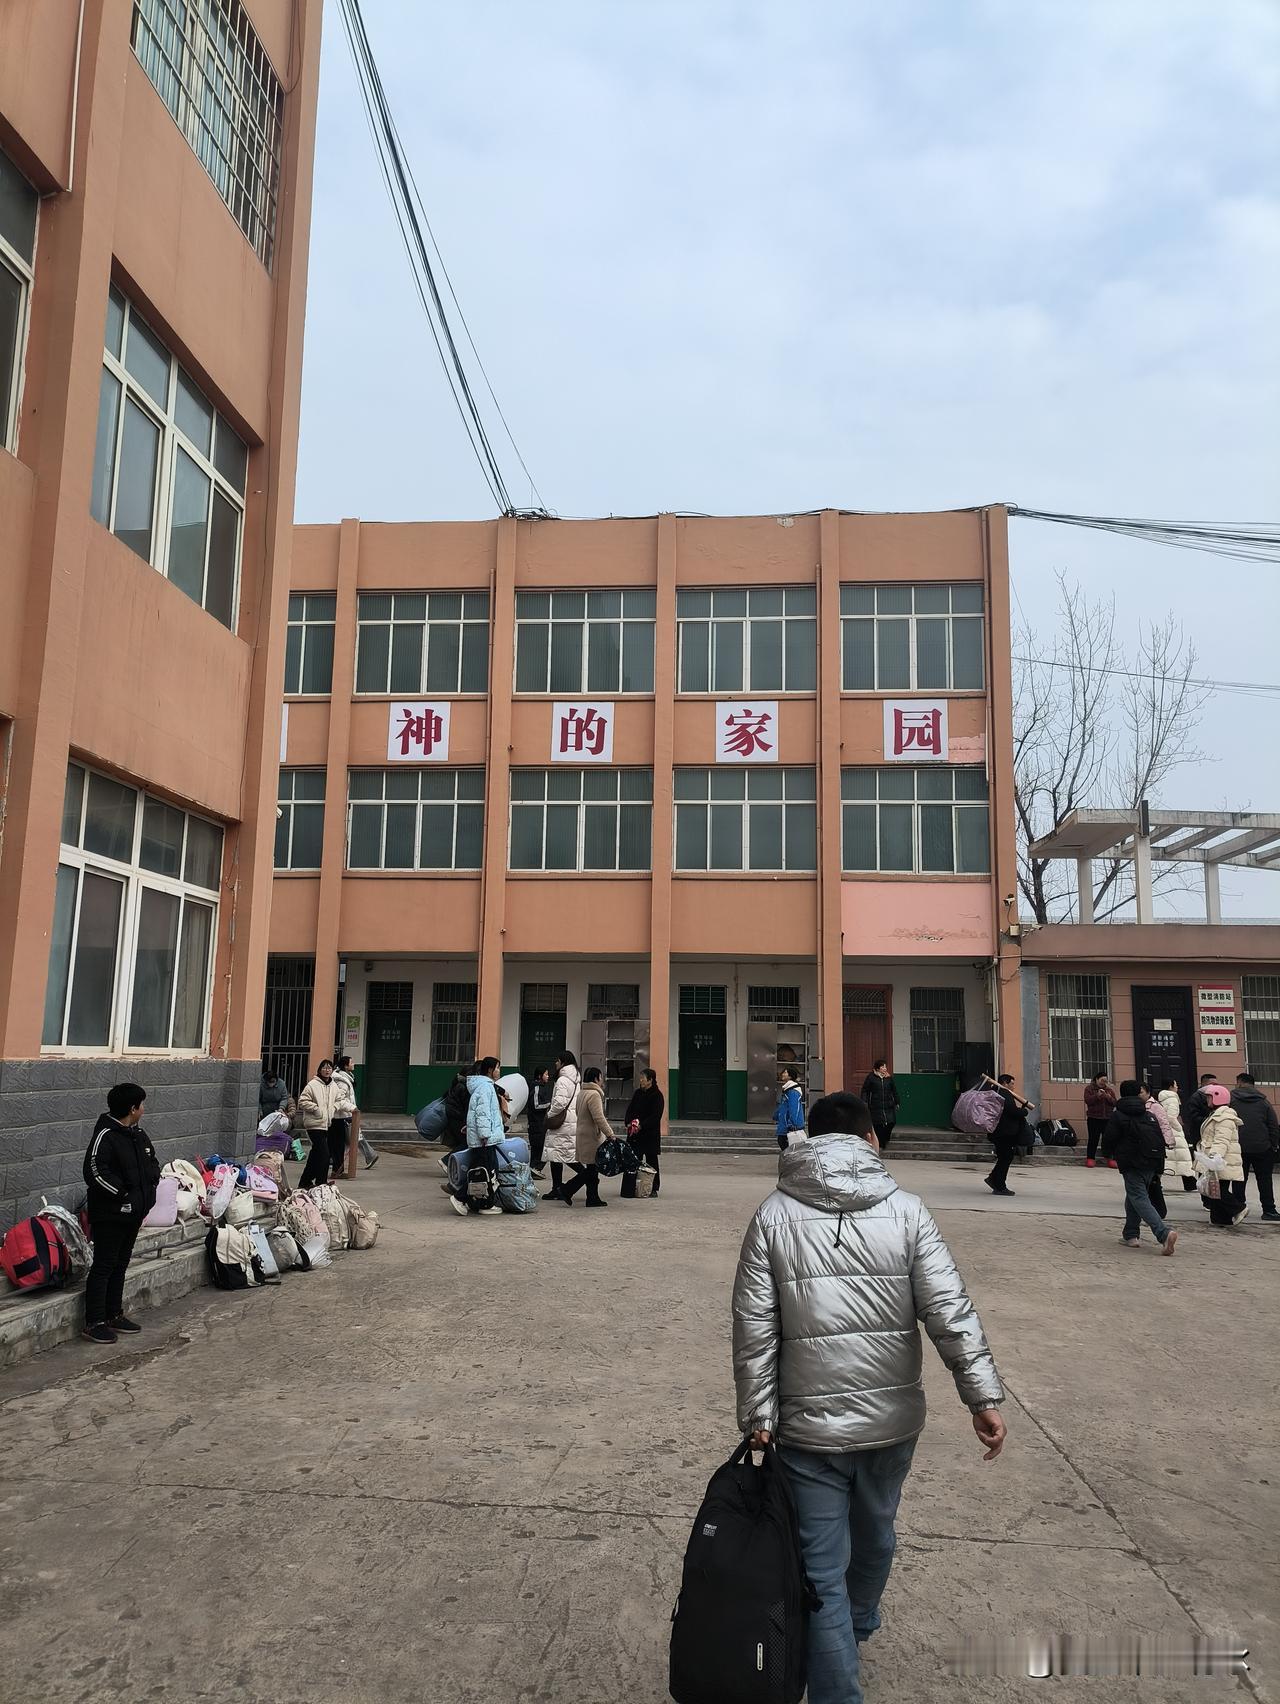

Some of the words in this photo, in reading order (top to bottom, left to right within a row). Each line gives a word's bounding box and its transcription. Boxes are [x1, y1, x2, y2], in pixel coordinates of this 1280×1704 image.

[395, 708, 942, 757] 神的家园
[1201, 993, 1232, 1001] 微型消防站
[1207, 1038, 1232, 1046] 监控室
